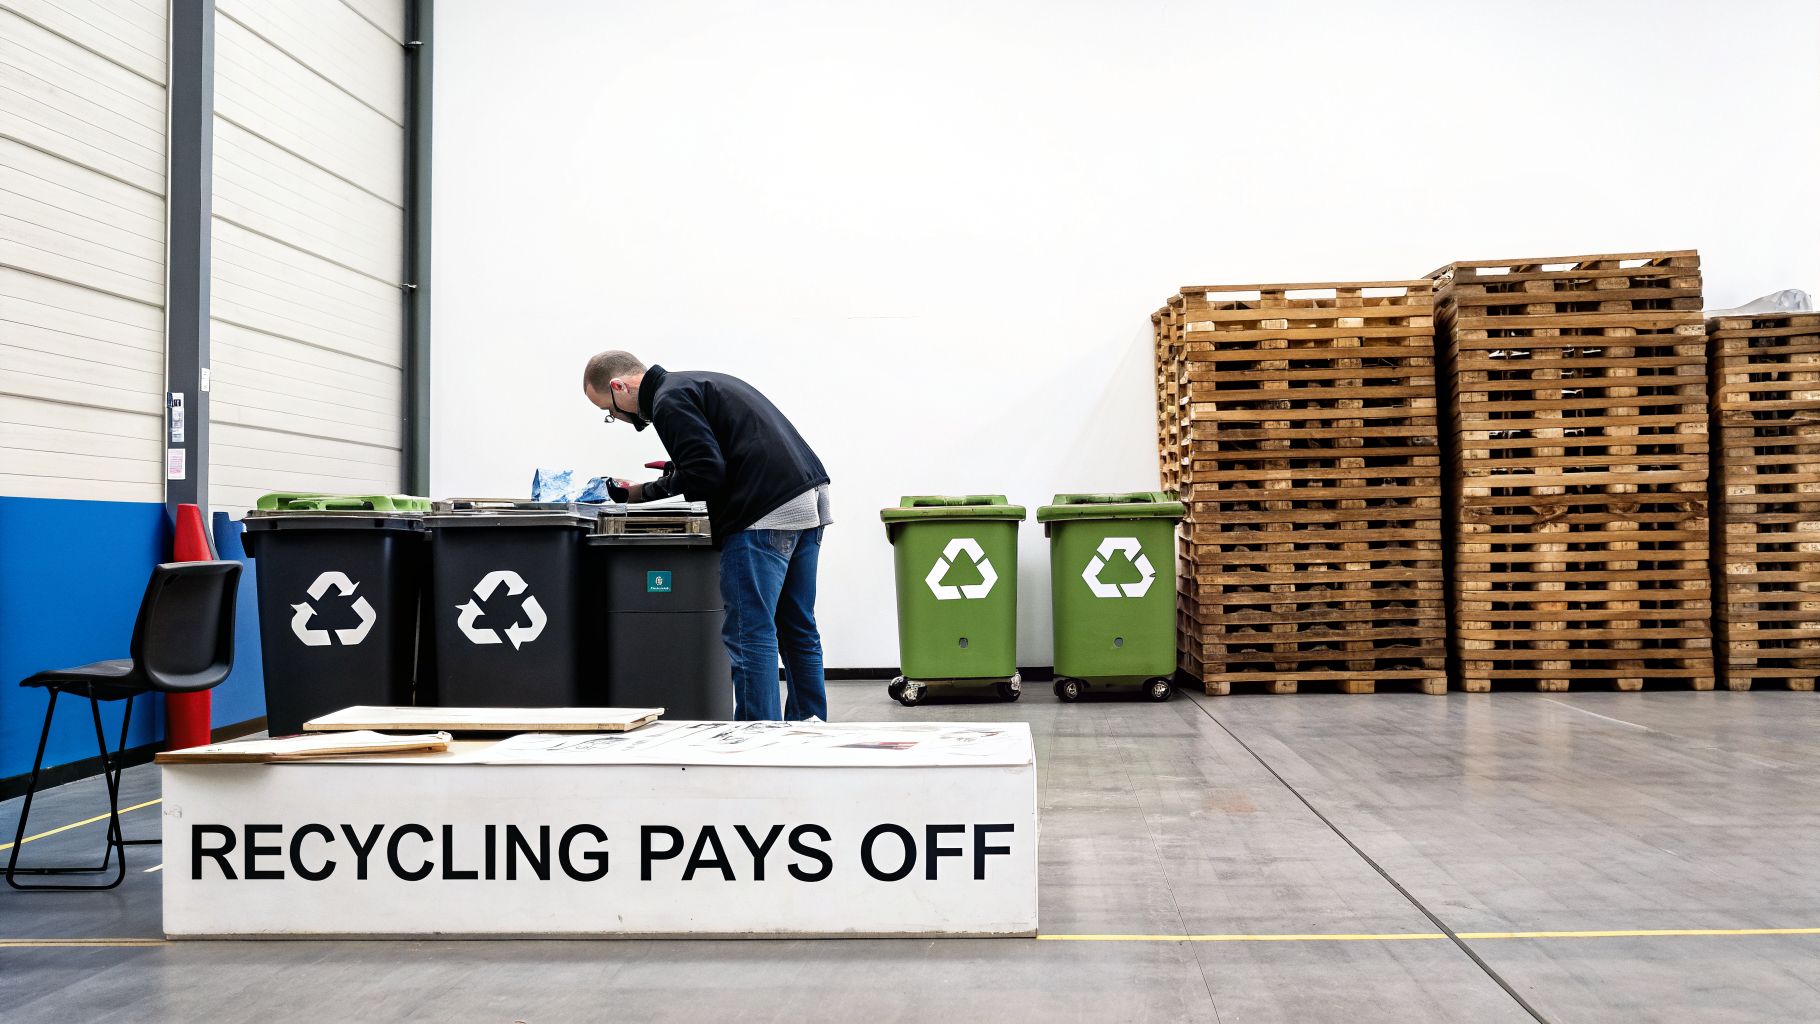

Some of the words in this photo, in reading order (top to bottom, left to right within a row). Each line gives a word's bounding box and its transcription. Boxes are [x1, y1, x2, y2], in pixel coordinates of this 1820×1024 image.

[191, 823, 608, 882] RECYCLING
[640, 823, 832, 882] PAYS
[860, 823, 1014, 881] OFF
